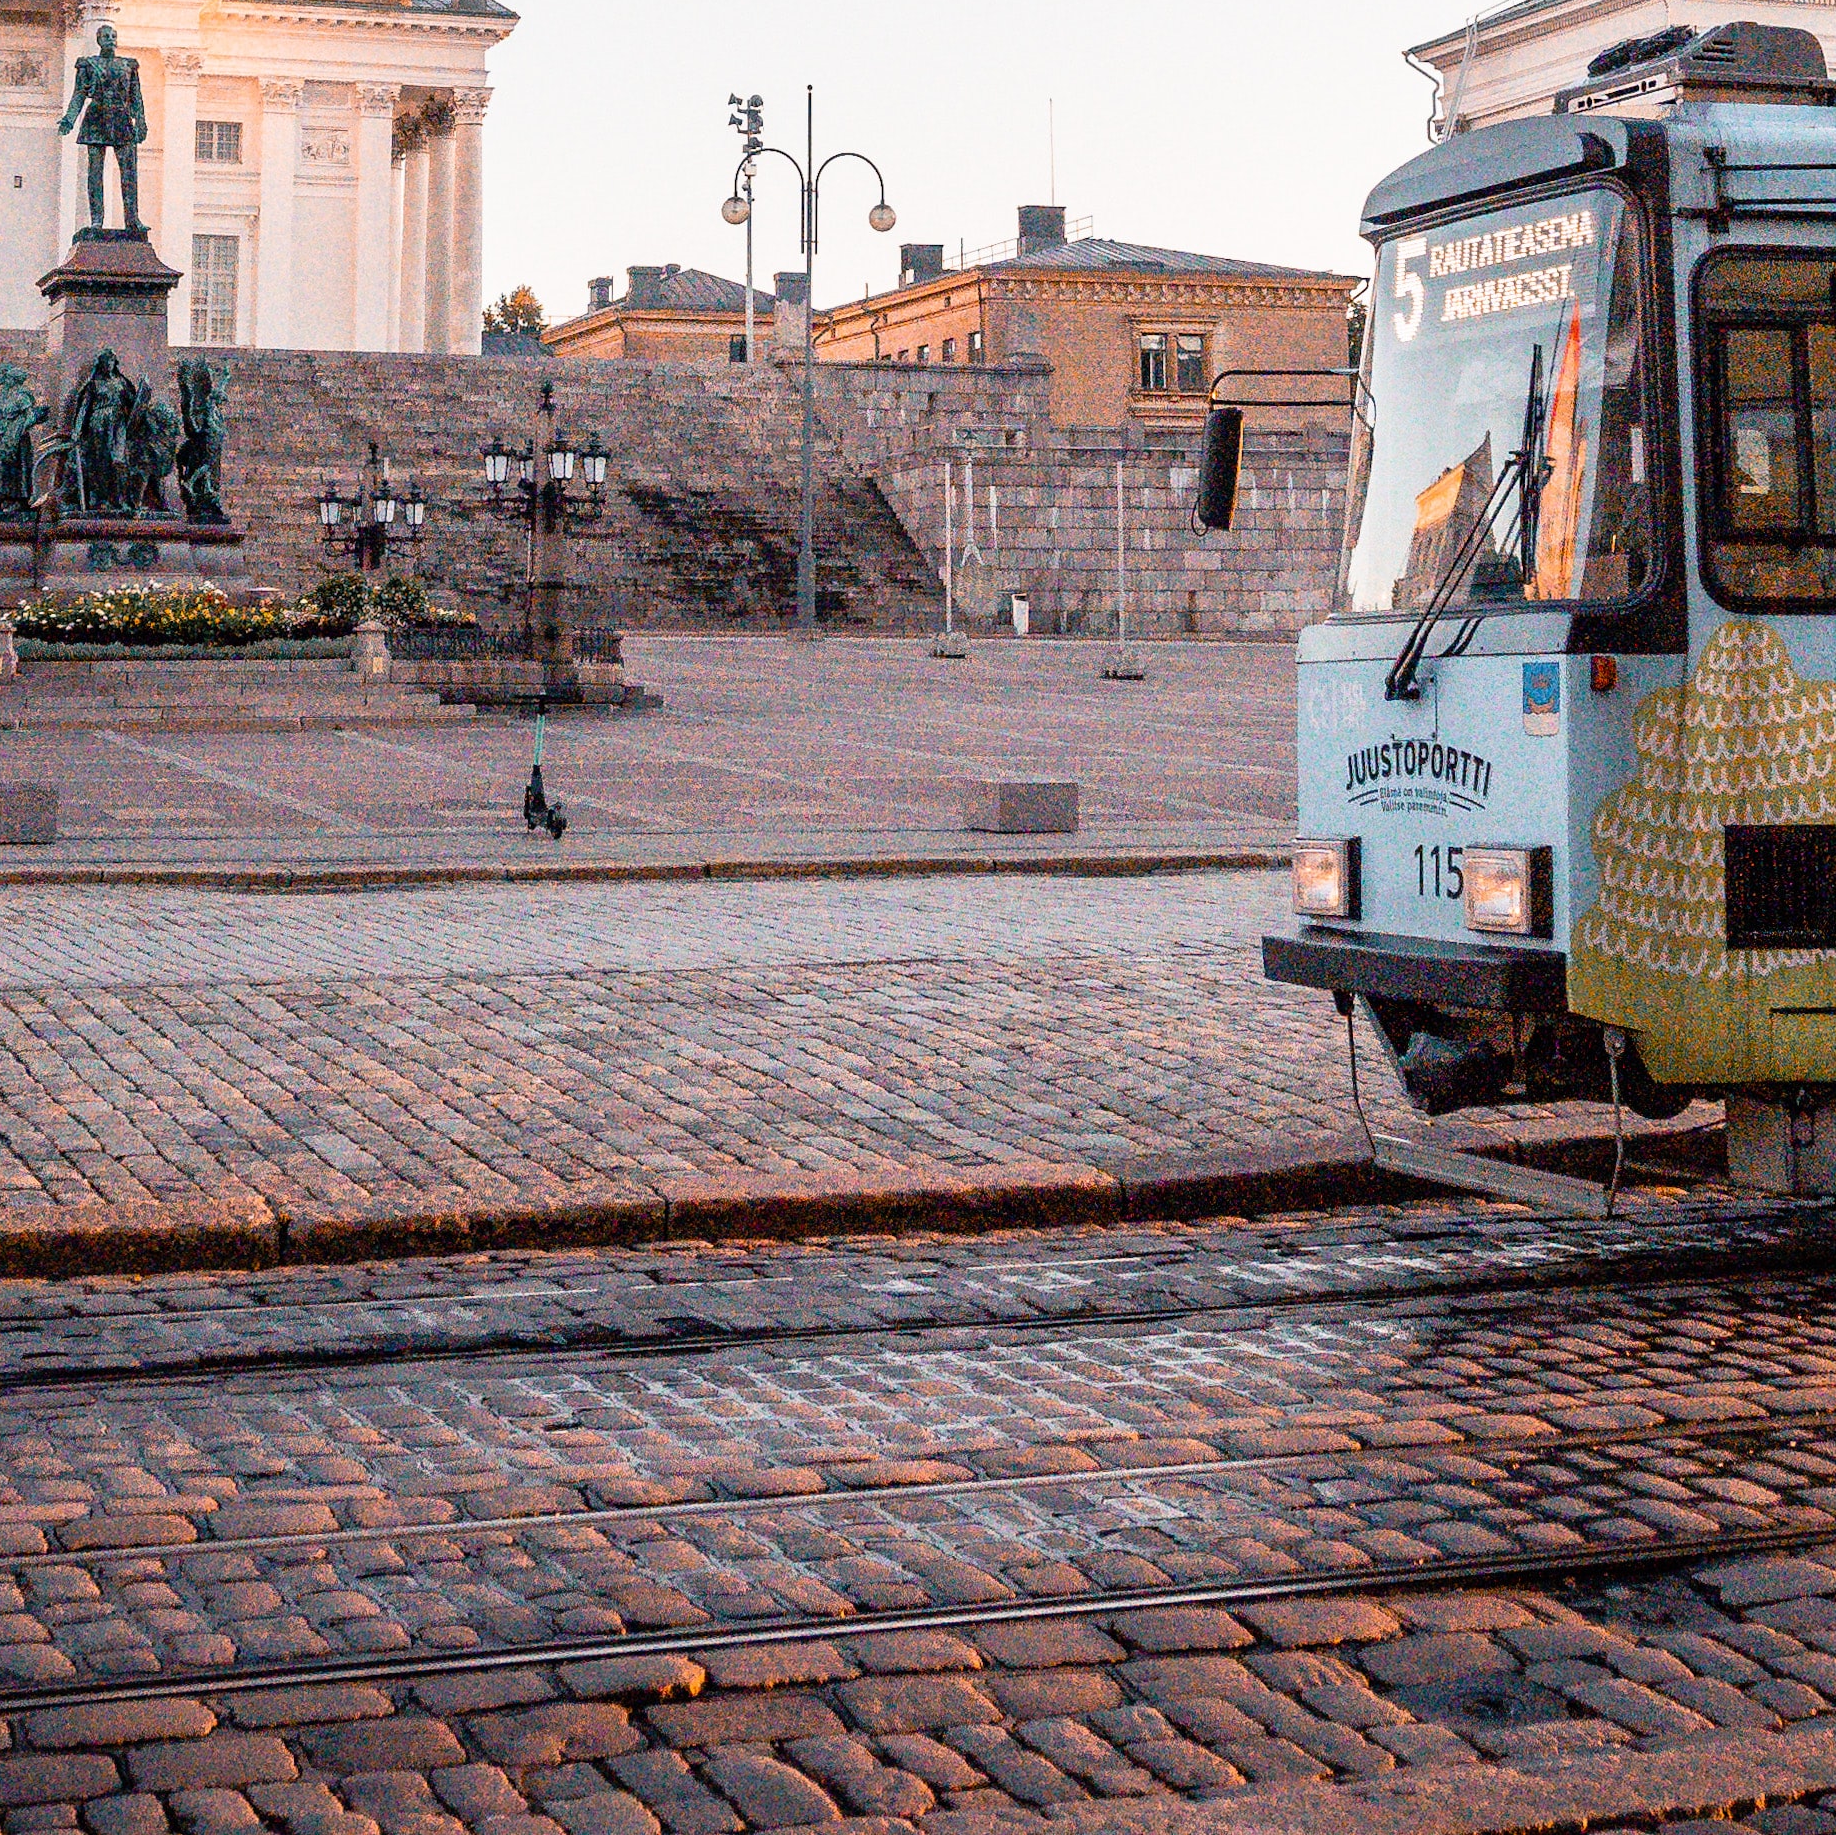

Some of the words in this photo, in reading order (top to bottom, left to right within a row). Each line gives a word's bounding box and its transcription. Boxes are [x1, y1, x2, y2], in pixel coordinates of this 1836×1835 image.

[1392, 237, 1427, 342] 5
[1346, 742, 1492, 797] JUUSTOPORTTI
[1415, 844, 1464, 899] 115
